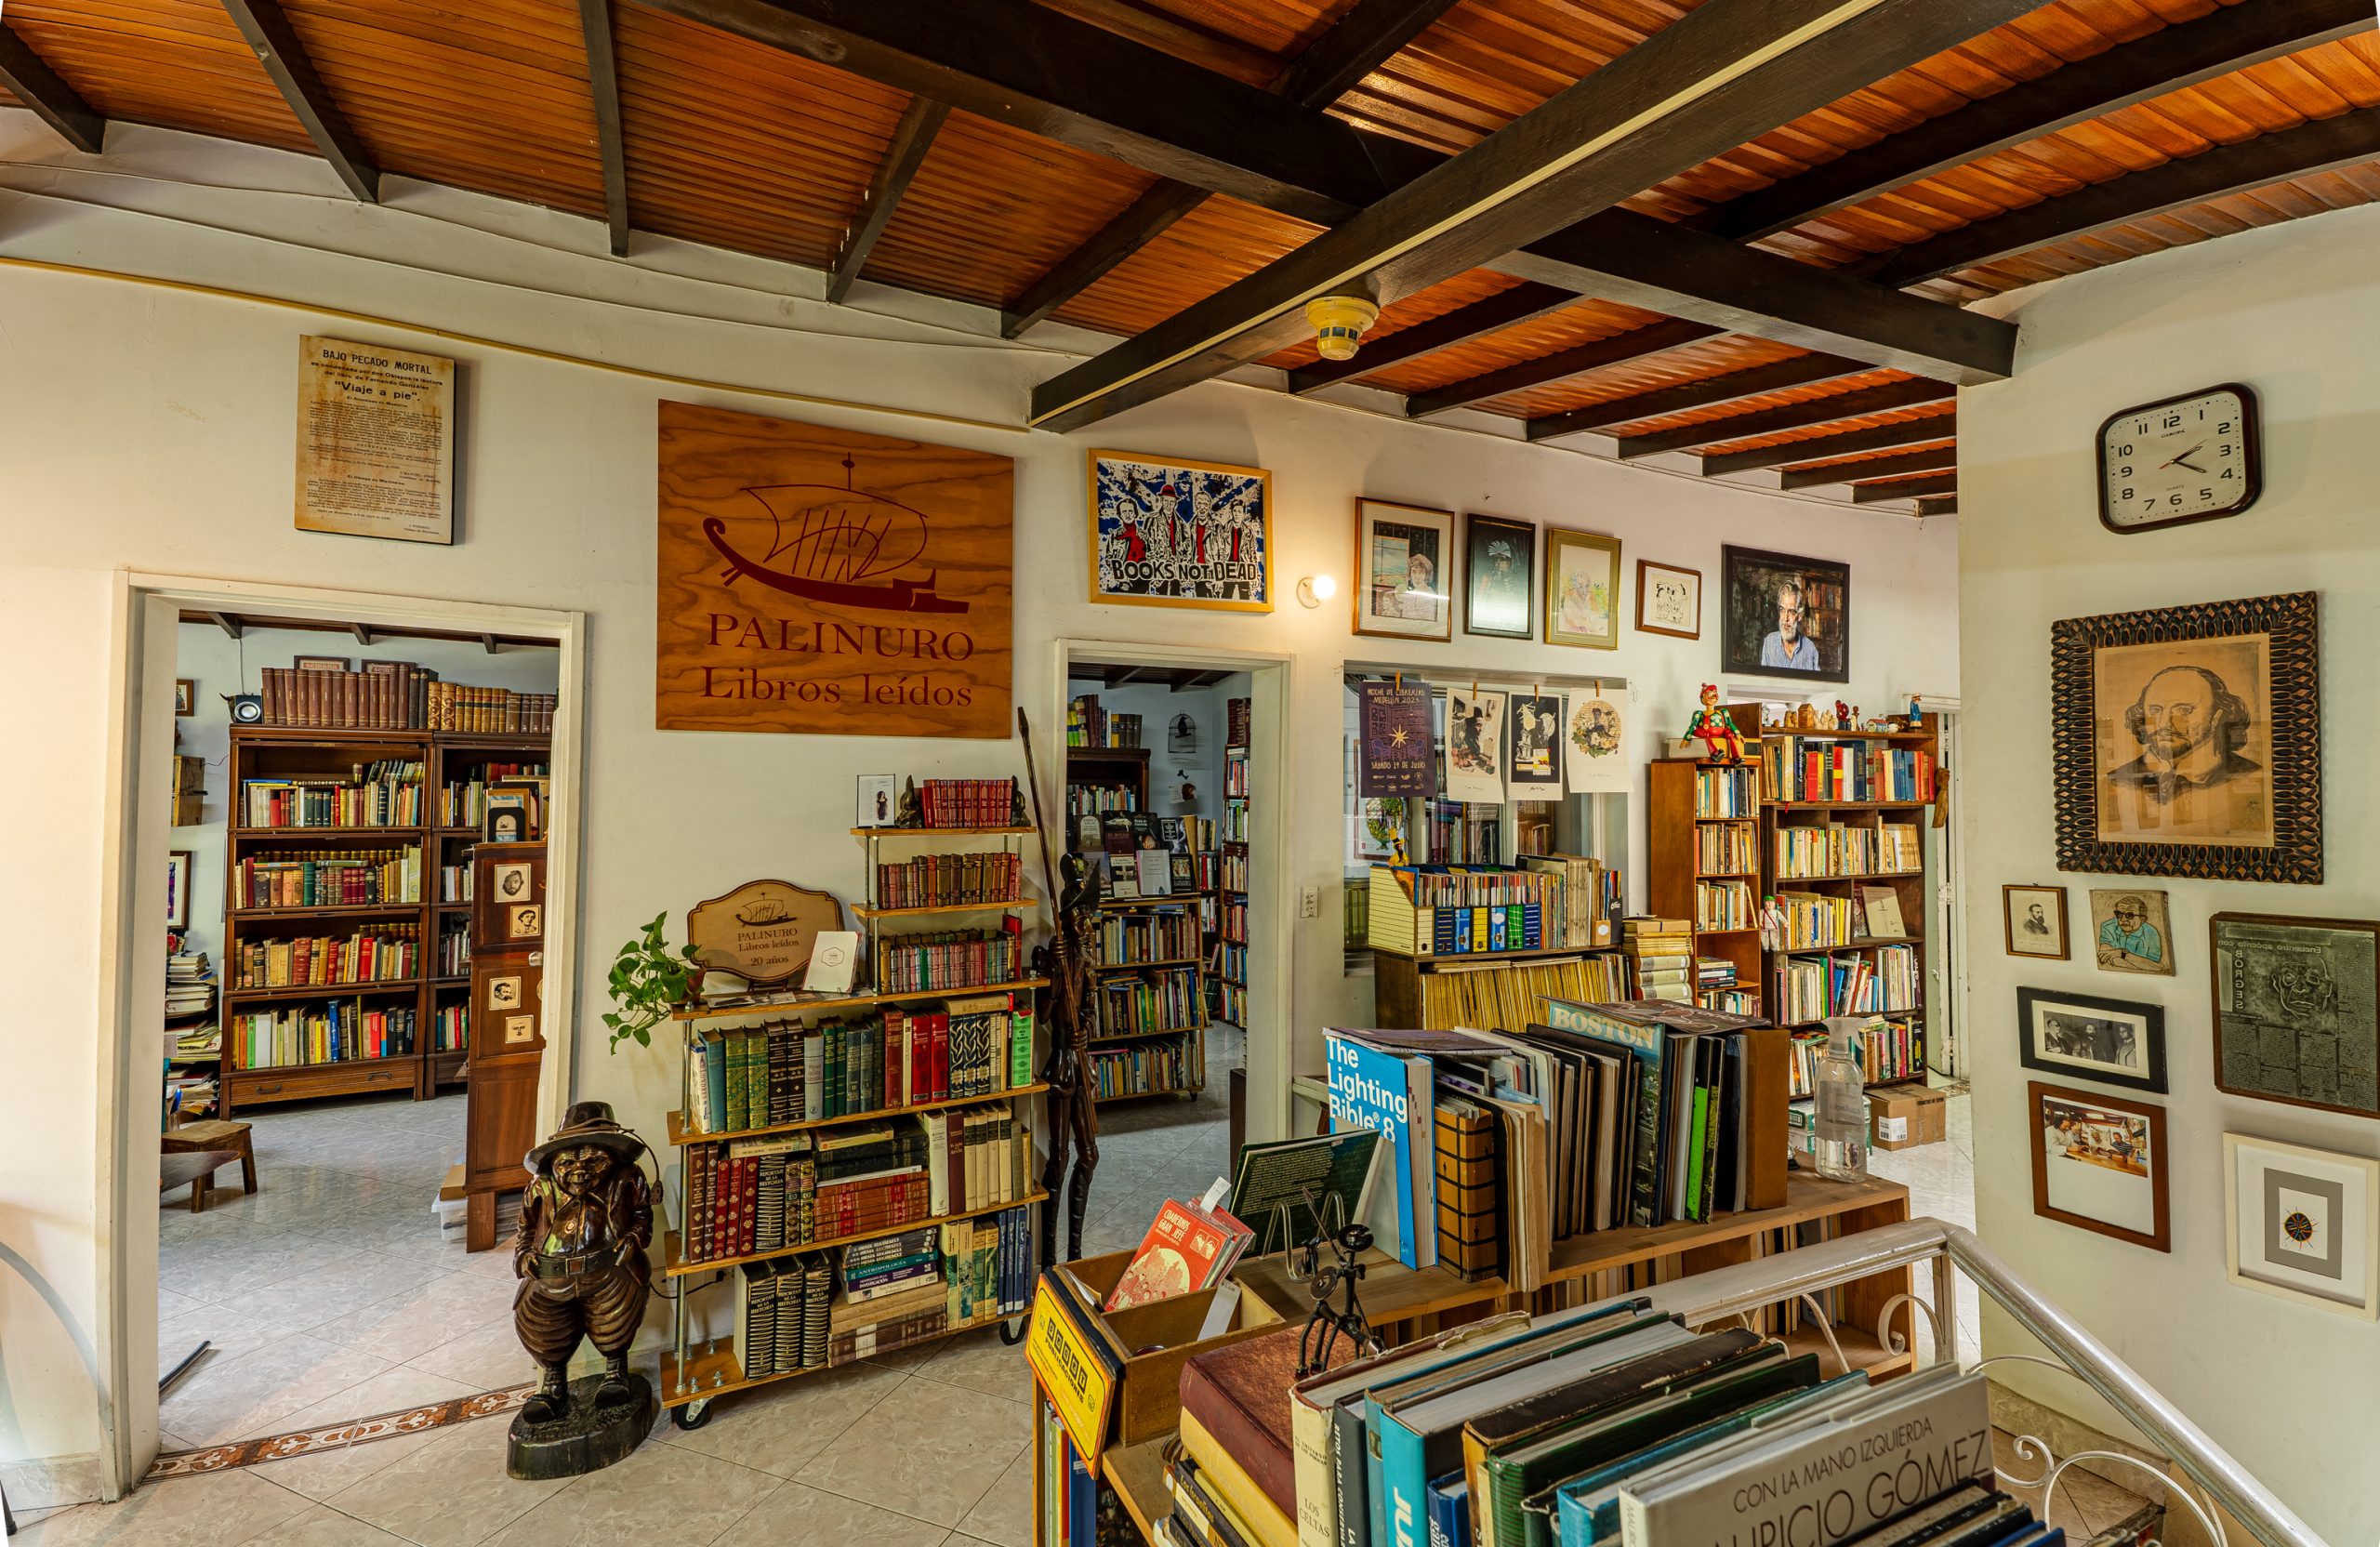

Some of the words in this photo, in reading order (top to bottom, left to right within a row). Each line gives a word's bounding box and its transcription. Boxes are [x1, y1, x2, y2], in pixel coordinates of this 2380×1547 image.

[323, 349, 347, 362] BAJO
[351, 353, 389, 368] PECADO
[394, 361, 432, 375] MORTAL
[2162, 416, 2181, 430] 12
[2199, 409, 2203, 421] 1
[2137, 422, 2149, 435] 11
[2217, 422, 2230, 434] 2
[2118, 444, 2134, 457] 10
[2219, 444, 2231, 456] 3
[2121, 466, 2133, 478] 9
[2219, 468, 2233, 480] 4
[2122, 488, 2134, 500] 8
[2169, 494, 2182, 506] 6
[2200, 488, 2213, 501] 5
[2143, 498, 2156, 511] 7
[1111, 559, 1175, 580] BOOKS
[1213, 561, 1257, 582] DEAD
[706, 612, 975, 662] PALINURO
[699, 665, 841, 705] Libros
[862, 672, 973, 707] leídos
[737, 927, 799, 942] PALINURO
[738, 942, 770, 953] Libros
[772, 939, 800, 949] leídos
[750, 956, 763, 967] 20
[765, 955, 789, 965] años
[1554, 1006, 1655, 1050] BOSTON
[1325, 1035, 1359, 1069] The
[1327, 1062, 1408, 1124] Lighting
[1382, 1116, 1396, 1144] 8
[858, 1260, 907, 1276] ANTROPOLOGÍA
[1044, 1337, 1085, 1404] PUBLICACIONES
[1334, 1422, 1342, 1457] RETOS
[1336, 1456, 1344, 1485] PARA
[1733, 1475, 1778, 1514] CON
[1782, 1468, 1801, 1496] LA
[1804, 1446, 1857, 1488] MANO
[1860, 1416, 1934, 1463] IZQUIERDA
[1180, 1474, 1190, 1493] Los
[1713, 1488, 1855, 1547] RICIO
[1866, 1428, 1990, 1521] GÓMEZ
[1303, 1497, 1320, 1518] LOS
[1299, 1507, 1331, 1540] CELTAS
[1347, 1527, 1356, 1546] LA
